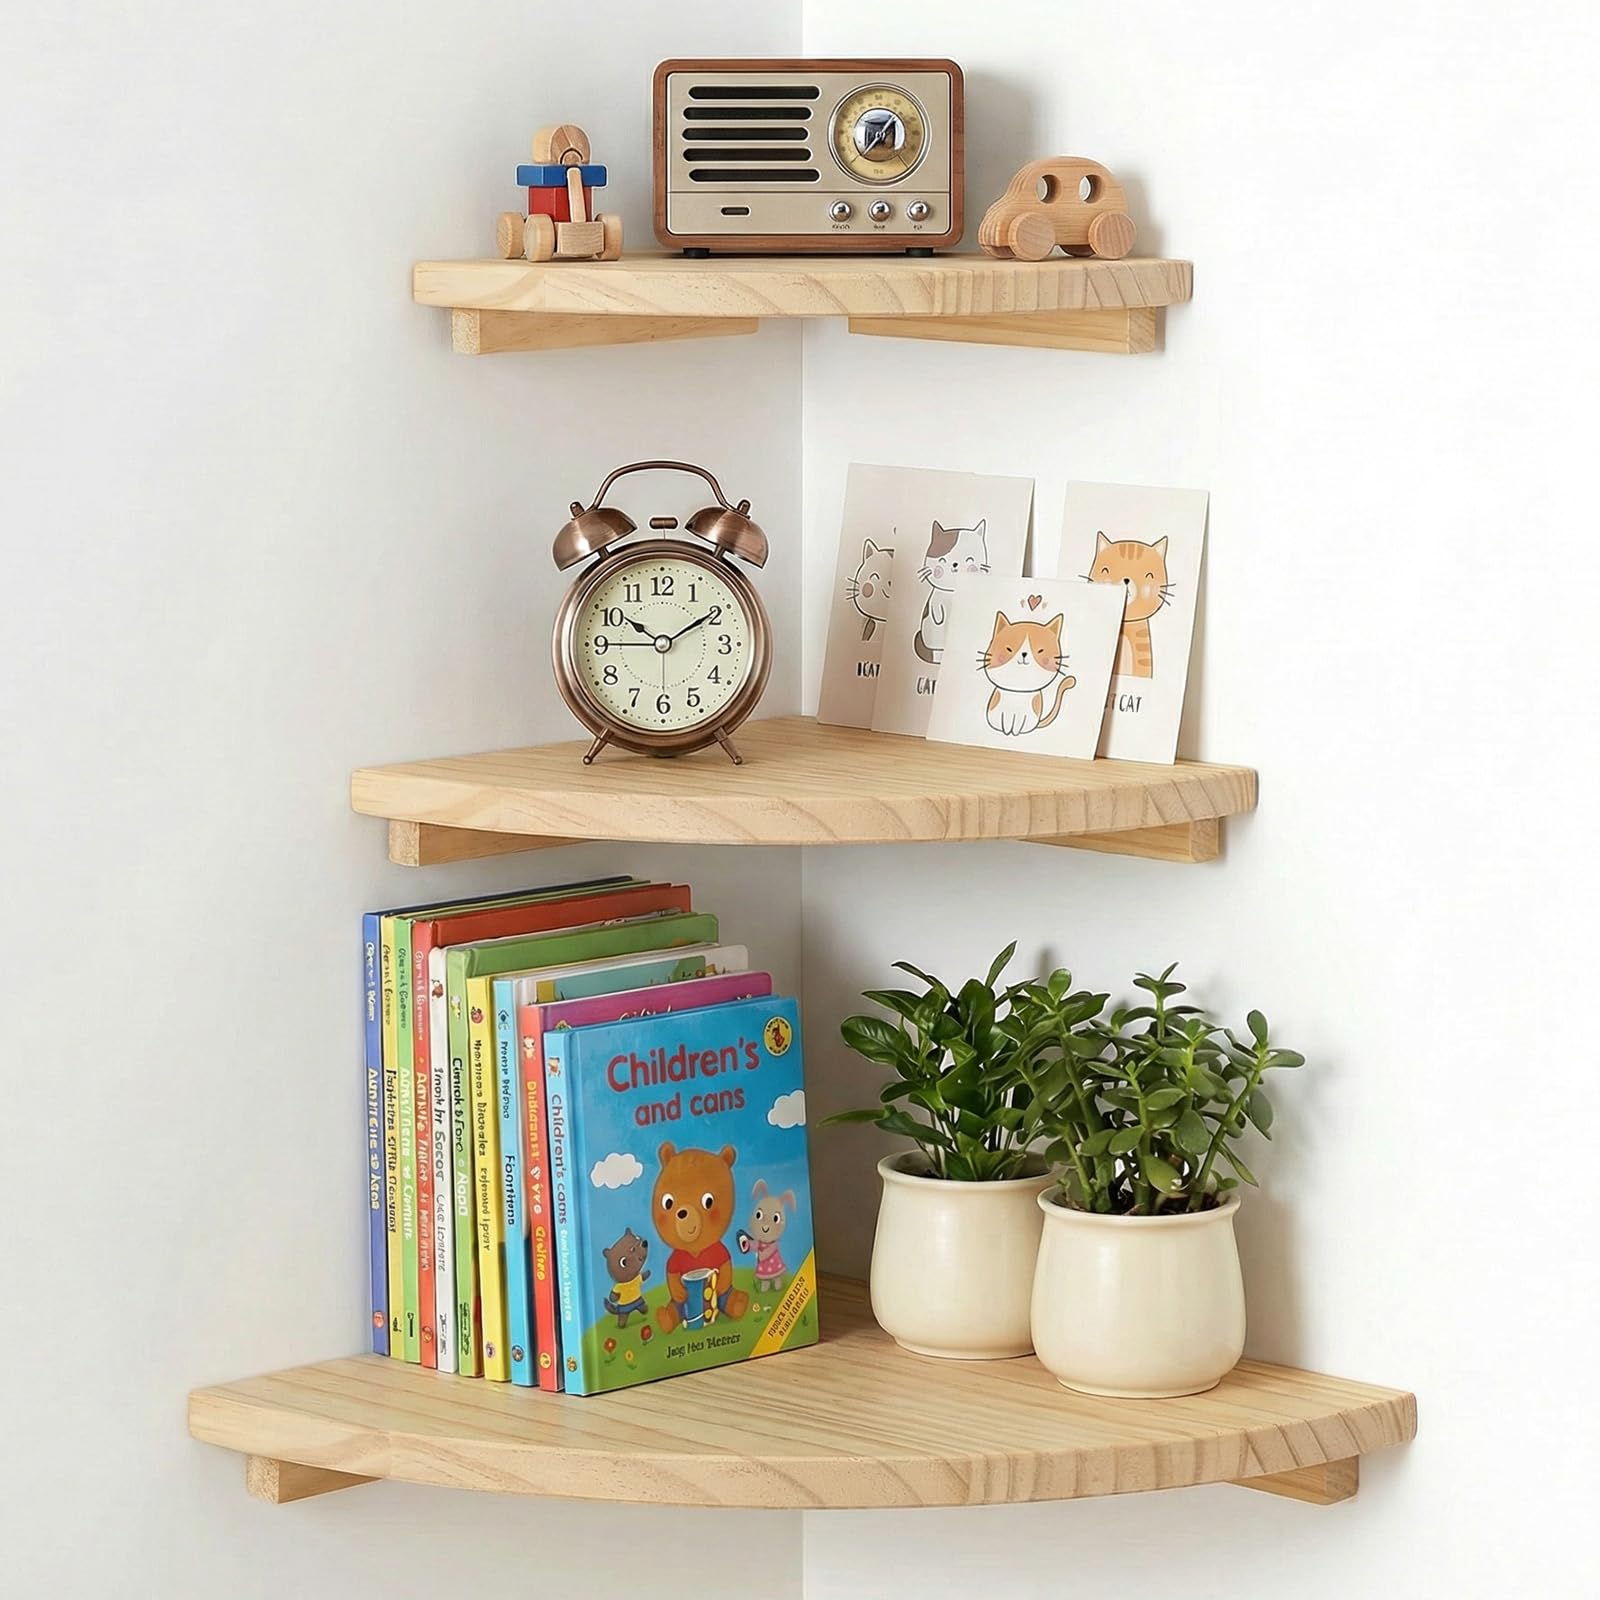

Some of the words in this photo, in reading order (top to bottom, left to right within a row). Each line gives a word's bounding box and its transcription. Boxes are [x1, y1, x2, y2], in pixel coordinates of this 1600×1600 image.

[623, 583, 643, 603] 11
[650, 576, 674, 596] 12
[688, 583, 699, 603] 1
[600, 607, 624, 627] 10
[708, 605, 722, 626] 2
[594, 635, 609, 655] 9
[717, 634, 732, 655] 3
[603, 665, 618, 685] 8
[707, 665, 722, 684] 4
[628, 688, 641, 708] 7
[656, 694, 671, 715] 6
[686, 687, 701, 707] 5
[1119, 694, 1142, 713] CAT
[607, 1036, 760, 1092] Children's
[634, 1092, 682, 1126] and
[689, 1088, 746, 1116] cans
